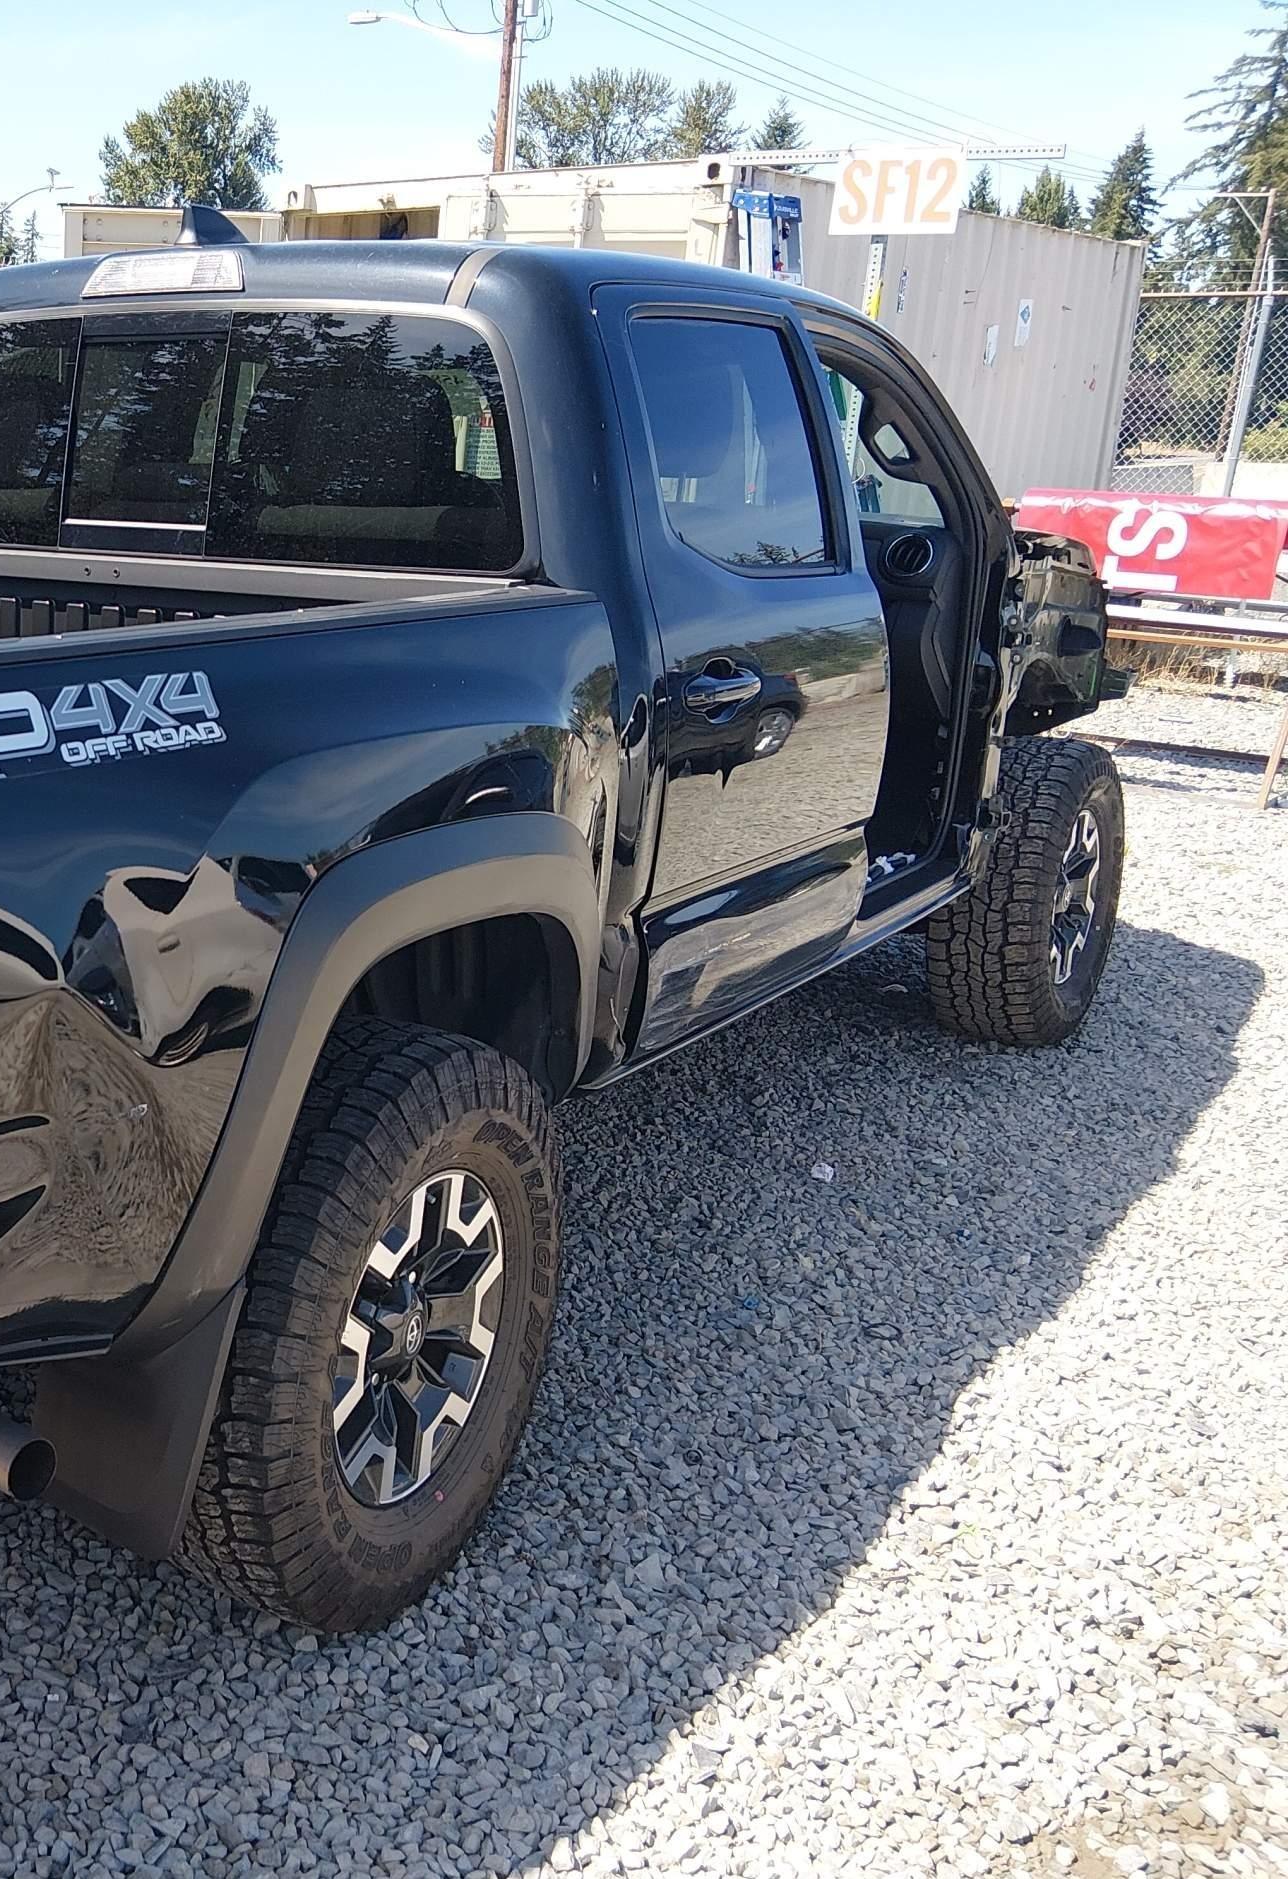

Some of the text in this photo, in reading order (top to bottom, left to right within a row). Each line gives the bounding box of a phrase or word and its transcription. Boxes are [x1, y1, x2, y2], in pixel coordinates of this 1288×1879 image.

[838, 157, 958, 226] SF12
[59, 719, 227, 767] OFF ROAD
[472, 1118, 534, 1169] OPEN
[520, 1166, 553, 1299] RANGE
